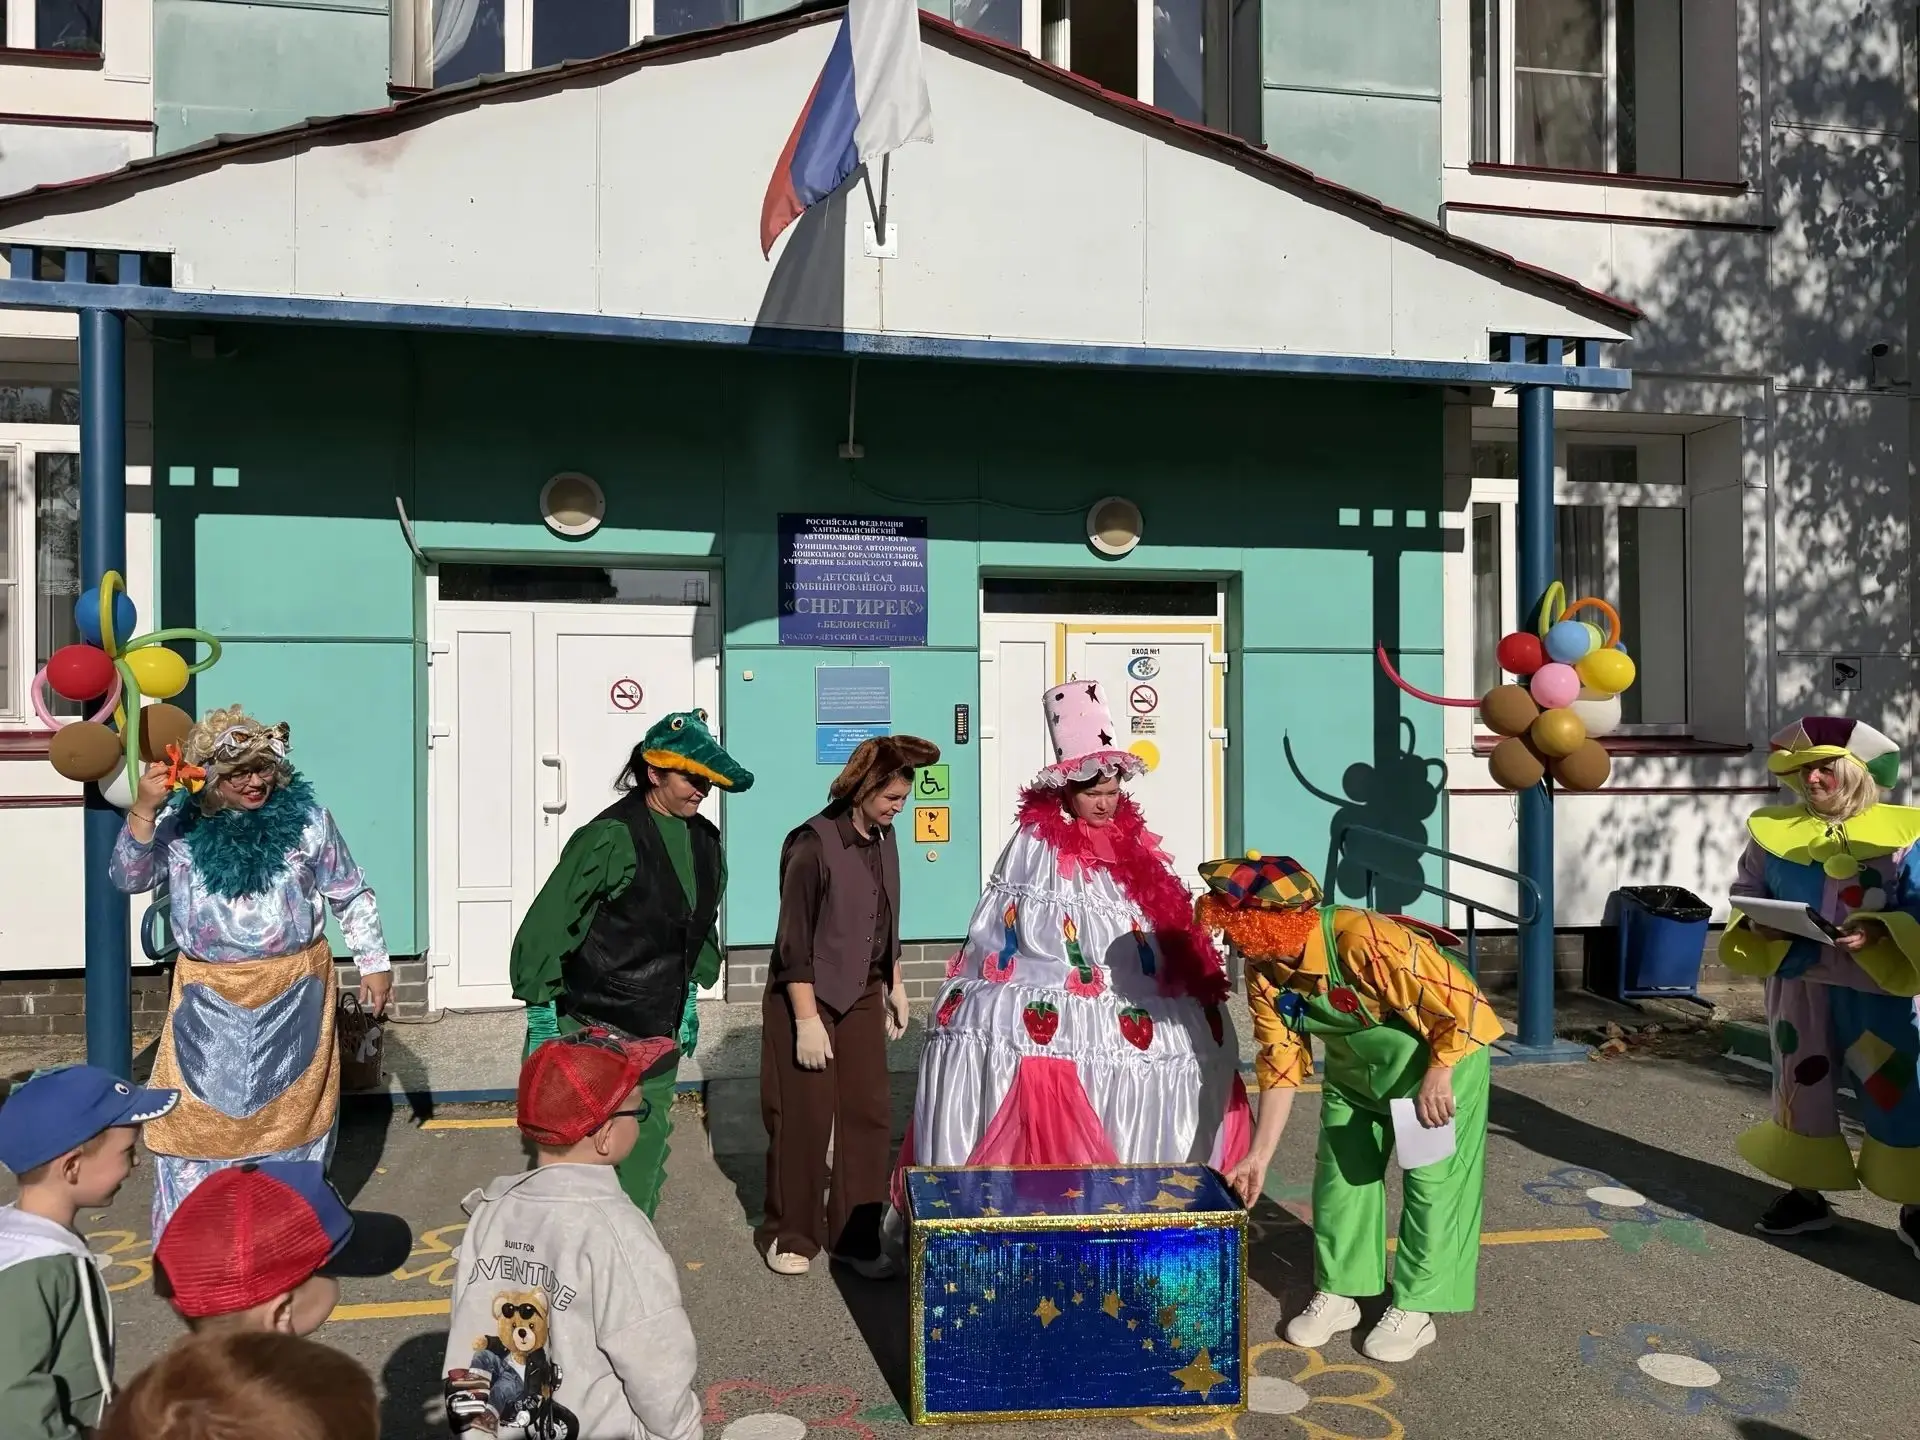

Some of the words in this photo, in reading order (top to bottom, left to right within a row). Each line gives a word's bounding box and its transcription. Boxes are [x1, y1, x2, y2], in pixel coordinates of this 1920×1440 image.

[805, 518, 857, 526] РОССИЙСКАЯ
[859, 519, 904, 528] ФЕДЕРАЦИЯ
[812, 526, 897, 535] ХАНТЫ-МАНСИЙСКИЙ
[792, 543, 863, 551] МУНИЦИПАЛЬНОЕ
[791, 551, 846, 559] ДОШКОЛЬНОЕ
[848, 551, 919, 560] ОБРАЗОВАТЕЛЬНОЕ
[783, 558, 835, 566] УЧРЕЖДЕНИЕ
[836, 559, 891, 567] БЕЛОЯРСКОГО
[893, 560, 924, 568] РАЙОНА
[873, 574, 893, 583] САД
[785, 582, 897, 592] КОМБИНИРОВАННОГО
[900, 584, 925, 593] ВИДА
[784, 597, 924, 616] «СНЕГИРЕК»
[1132, 648, 1149, 656] ВХОД
[504, 1240, 522, 1250] BUILT
[522, 1243, 535, 1253] FOR
